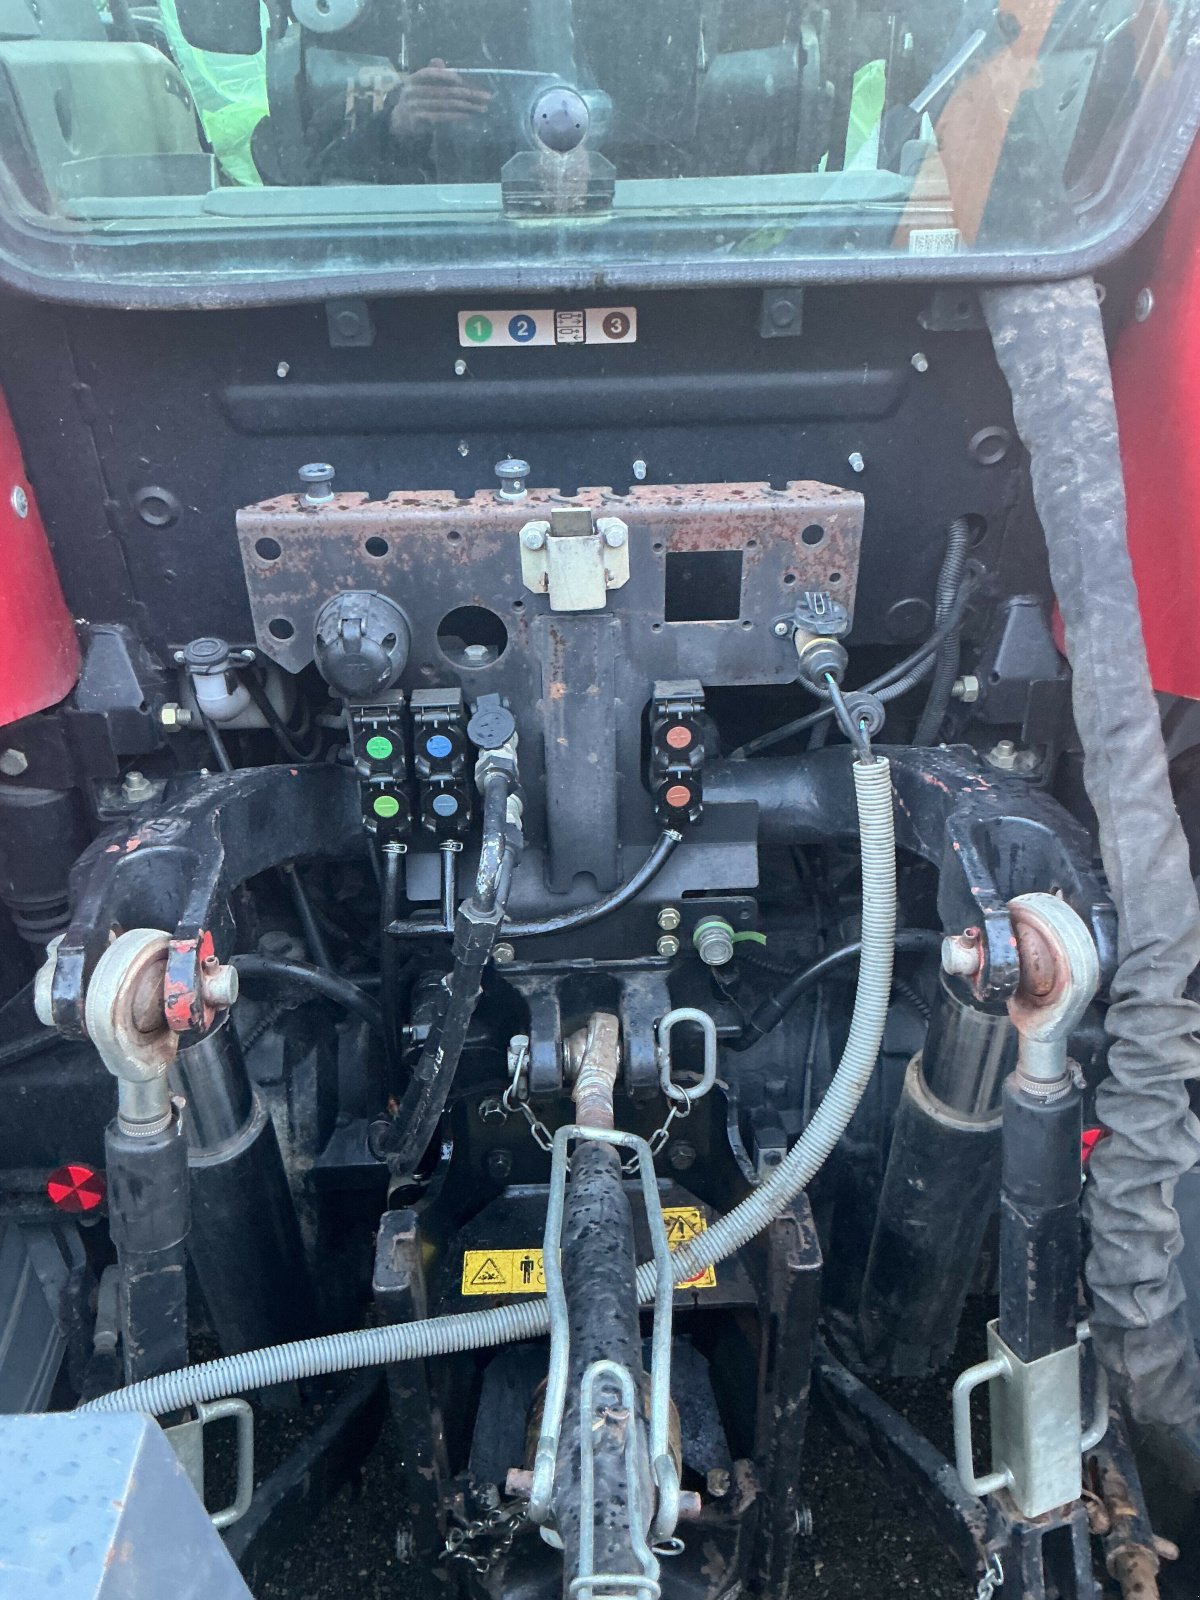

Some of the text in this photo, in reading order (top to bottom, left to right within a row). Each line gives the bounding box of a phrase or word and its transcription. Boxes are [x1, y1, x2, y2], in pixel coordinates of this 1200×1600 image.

[473, 318, 622, 336] 1 2 3
